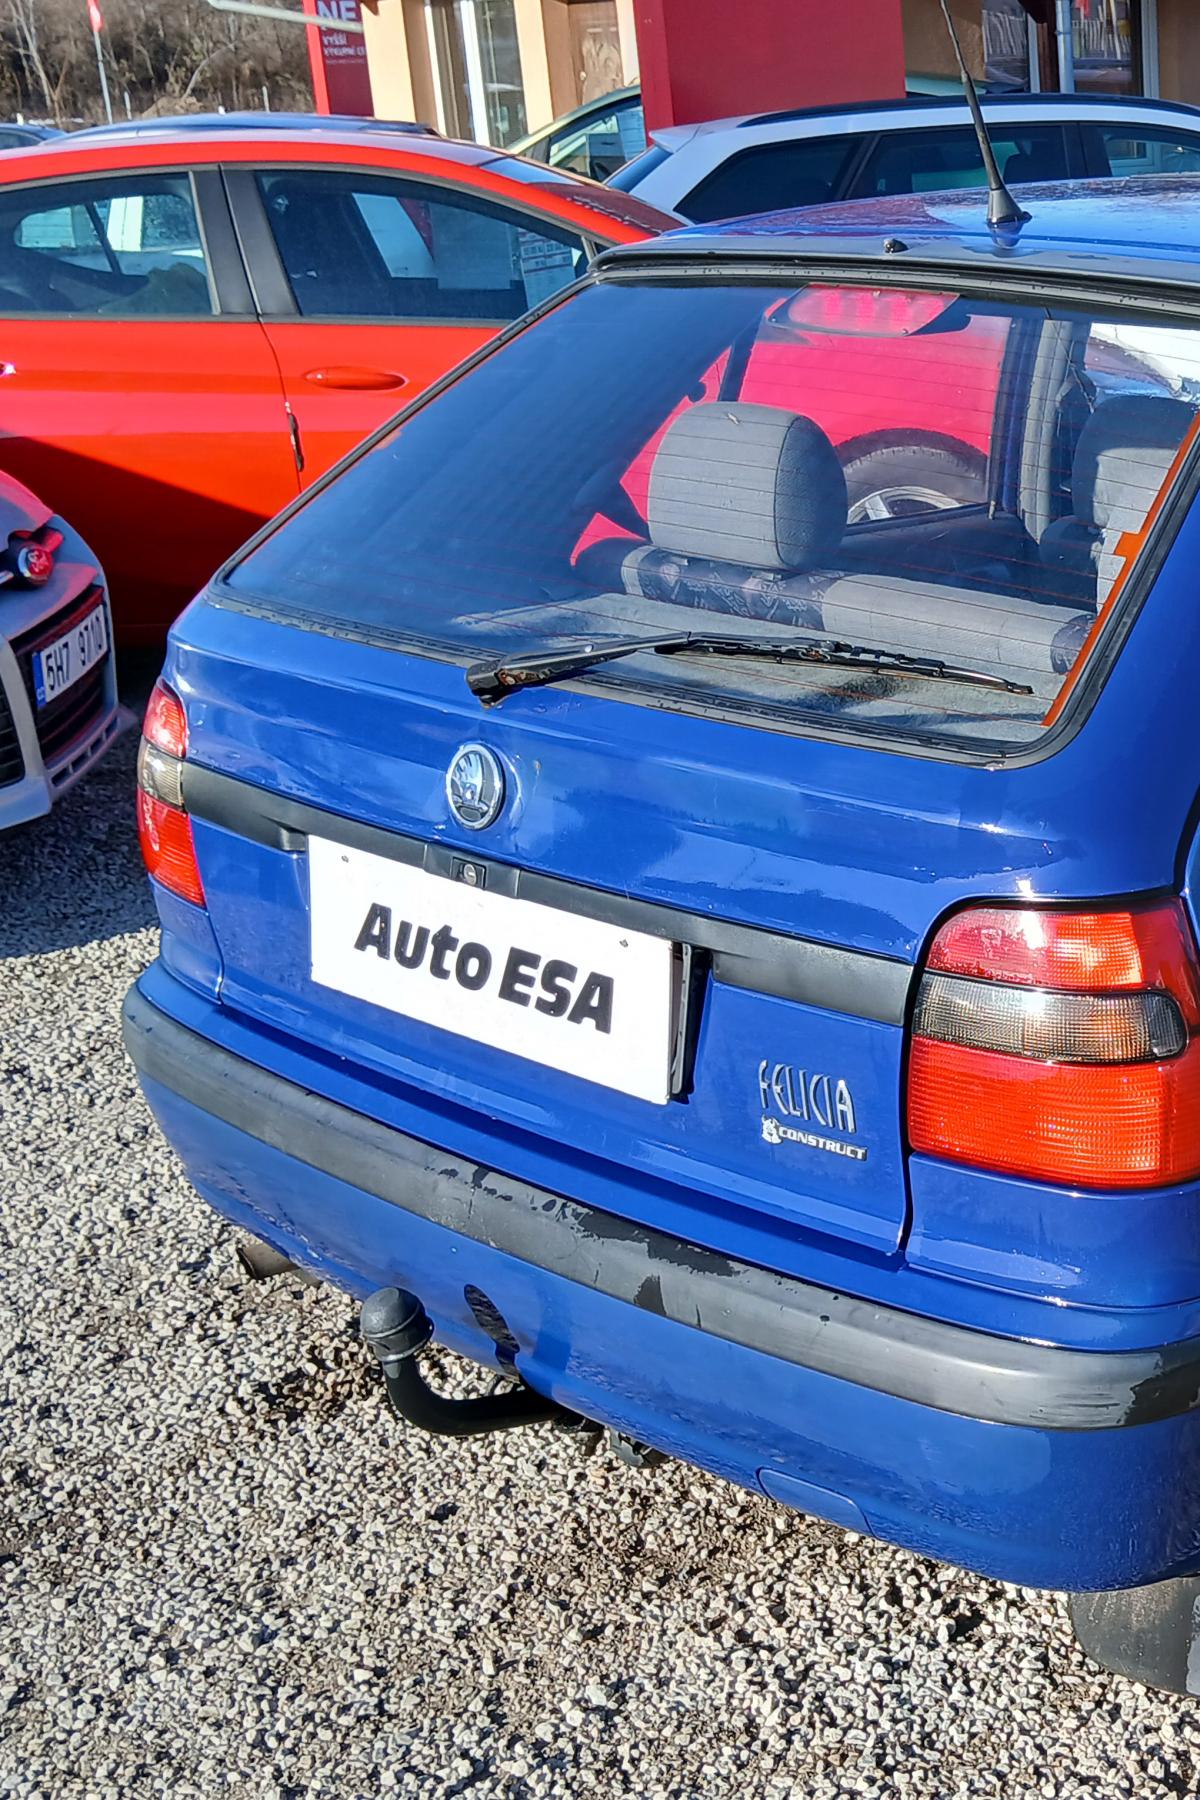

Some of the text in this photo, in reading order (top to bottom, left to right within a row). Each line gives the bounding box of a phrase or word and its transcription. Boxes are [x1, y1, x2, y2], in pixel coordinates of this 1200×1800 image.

[45, 641, 69, 691] 5H7
[354, 902, 615, 1035] Auto ESA
[759, 1060, 857, 1134] FELICIA
[779, 1126, 867, 1160] CONSTRUCT
